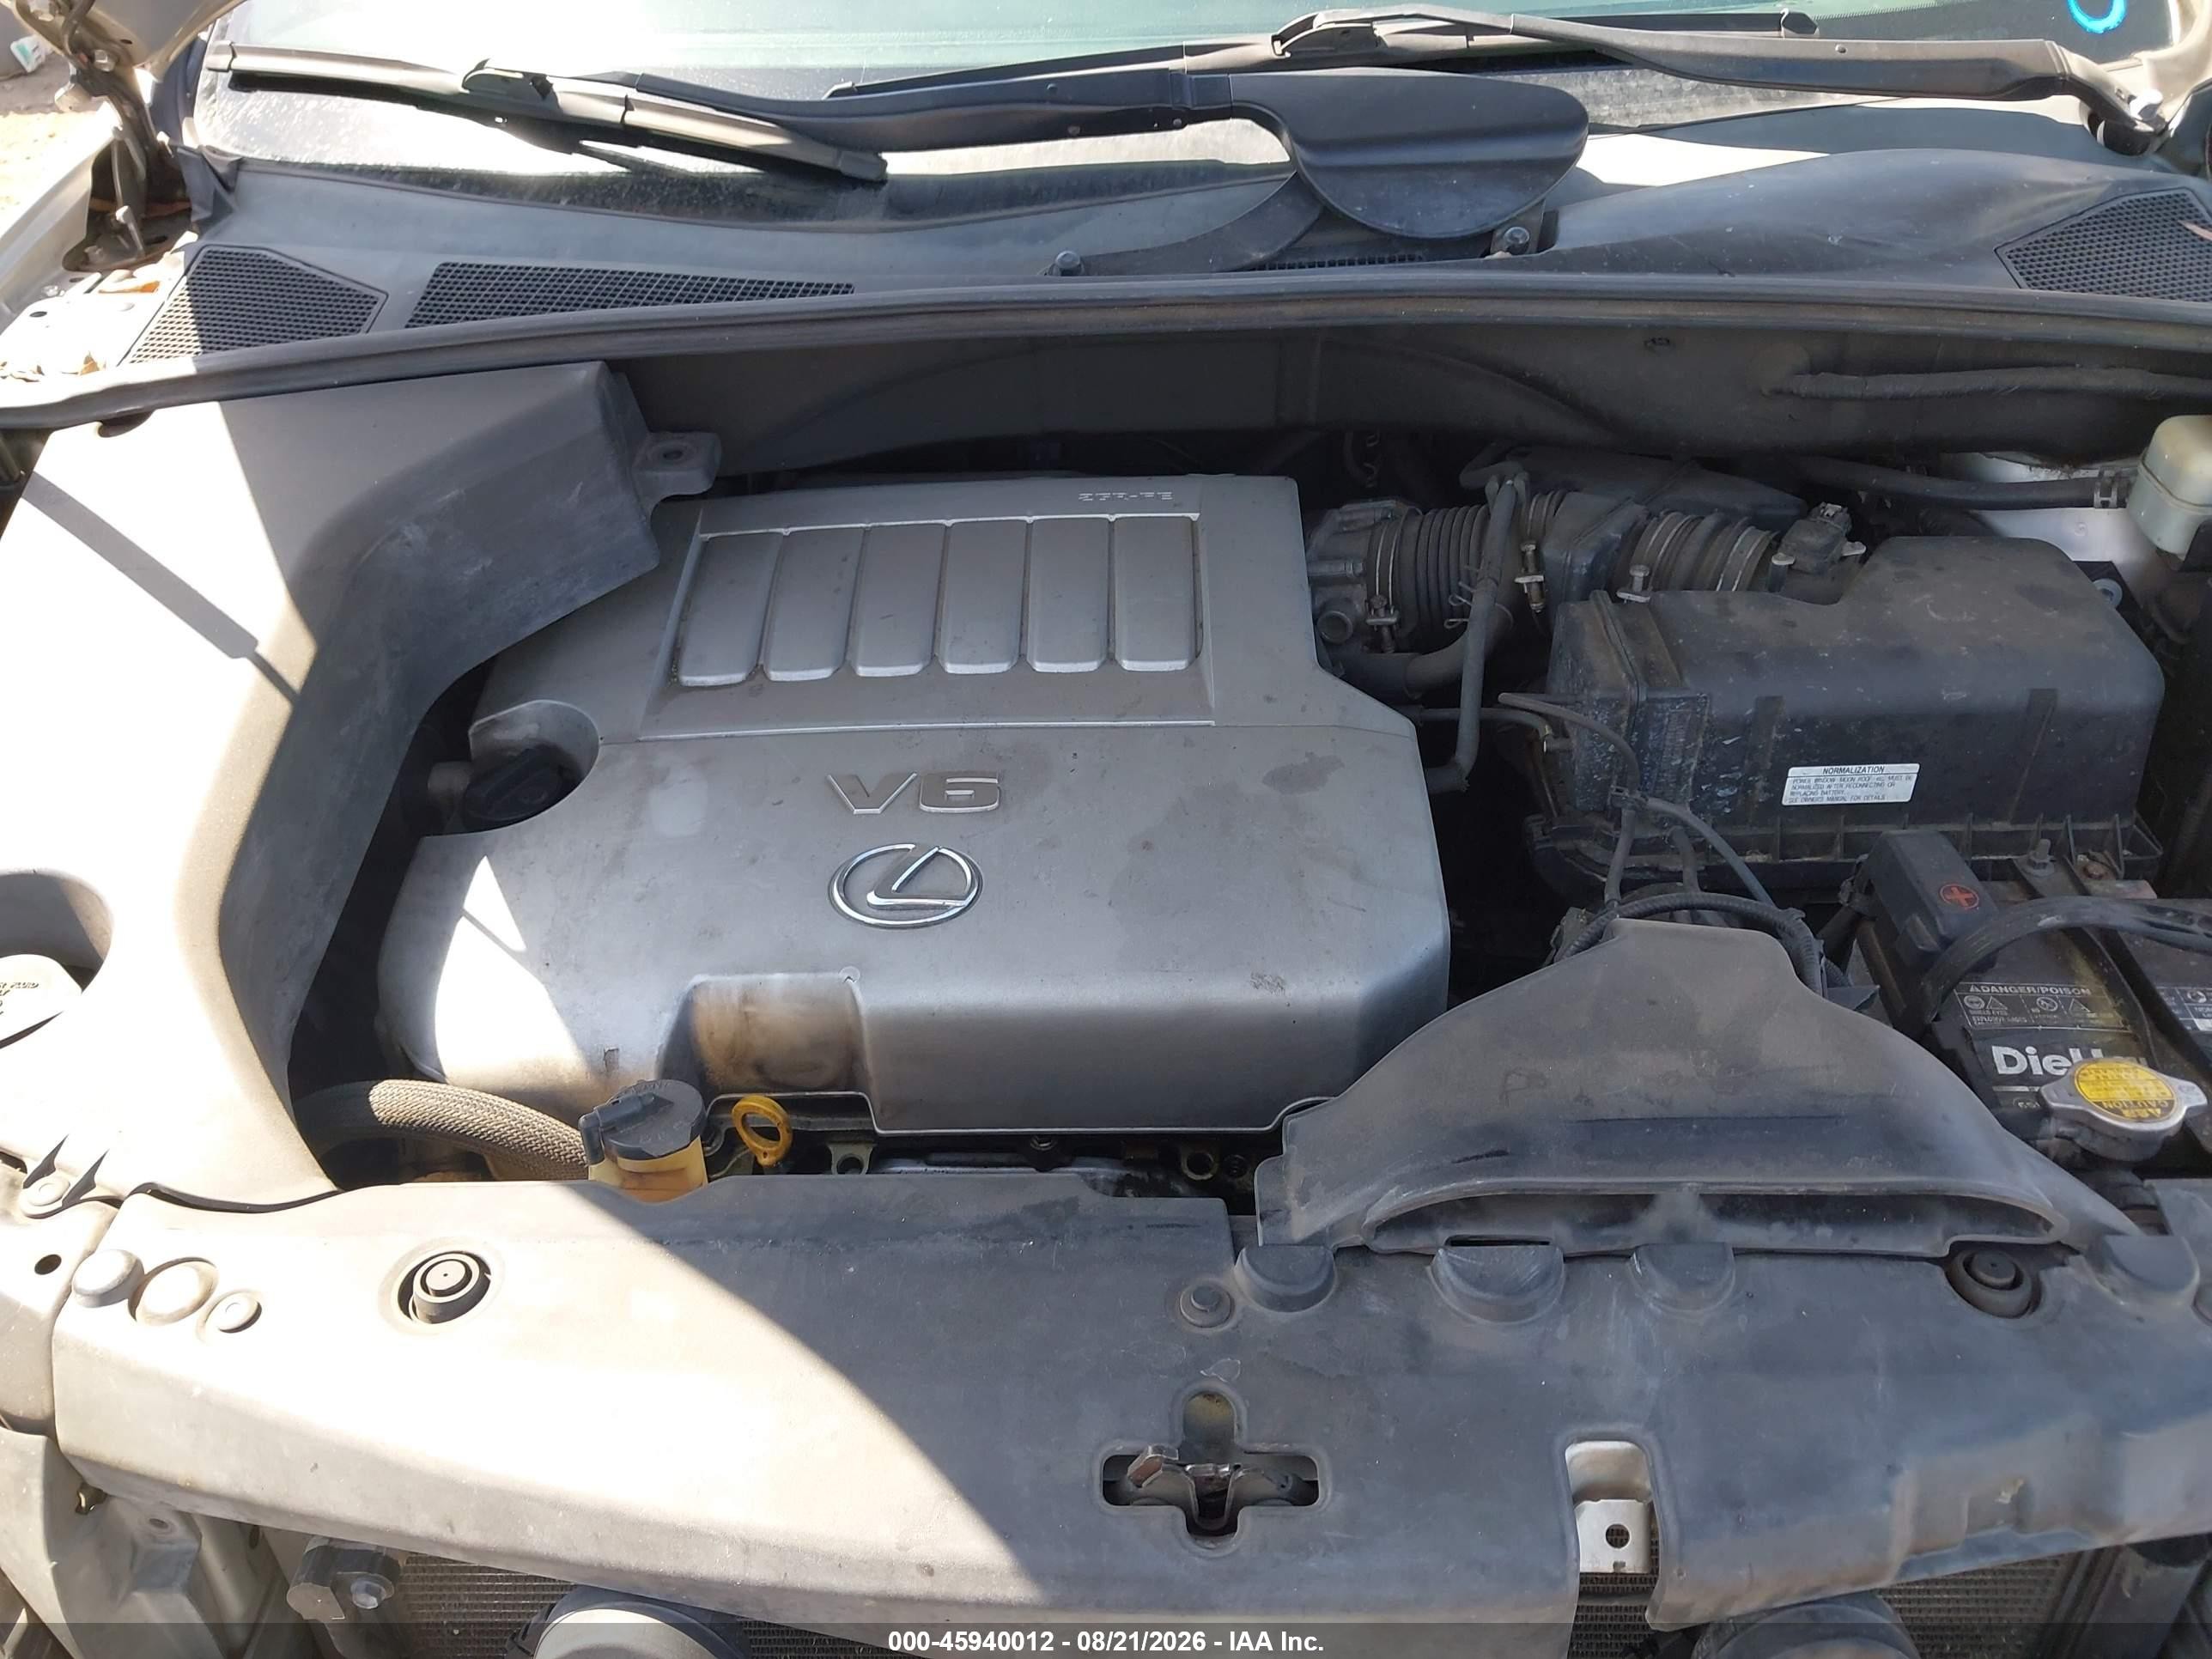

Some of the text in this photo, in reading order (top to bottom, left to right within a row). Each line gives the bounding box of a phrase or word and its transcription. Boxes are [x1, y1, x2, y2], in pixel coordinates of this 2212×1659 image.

[1822, 766, 1885, 775] NORMALIZATION
[827, 771, 1000, 815] V6
[1980, 985, 2092, 996] DANGER/POISON
[2102, 1100, 2168, 1109] CAUTION
